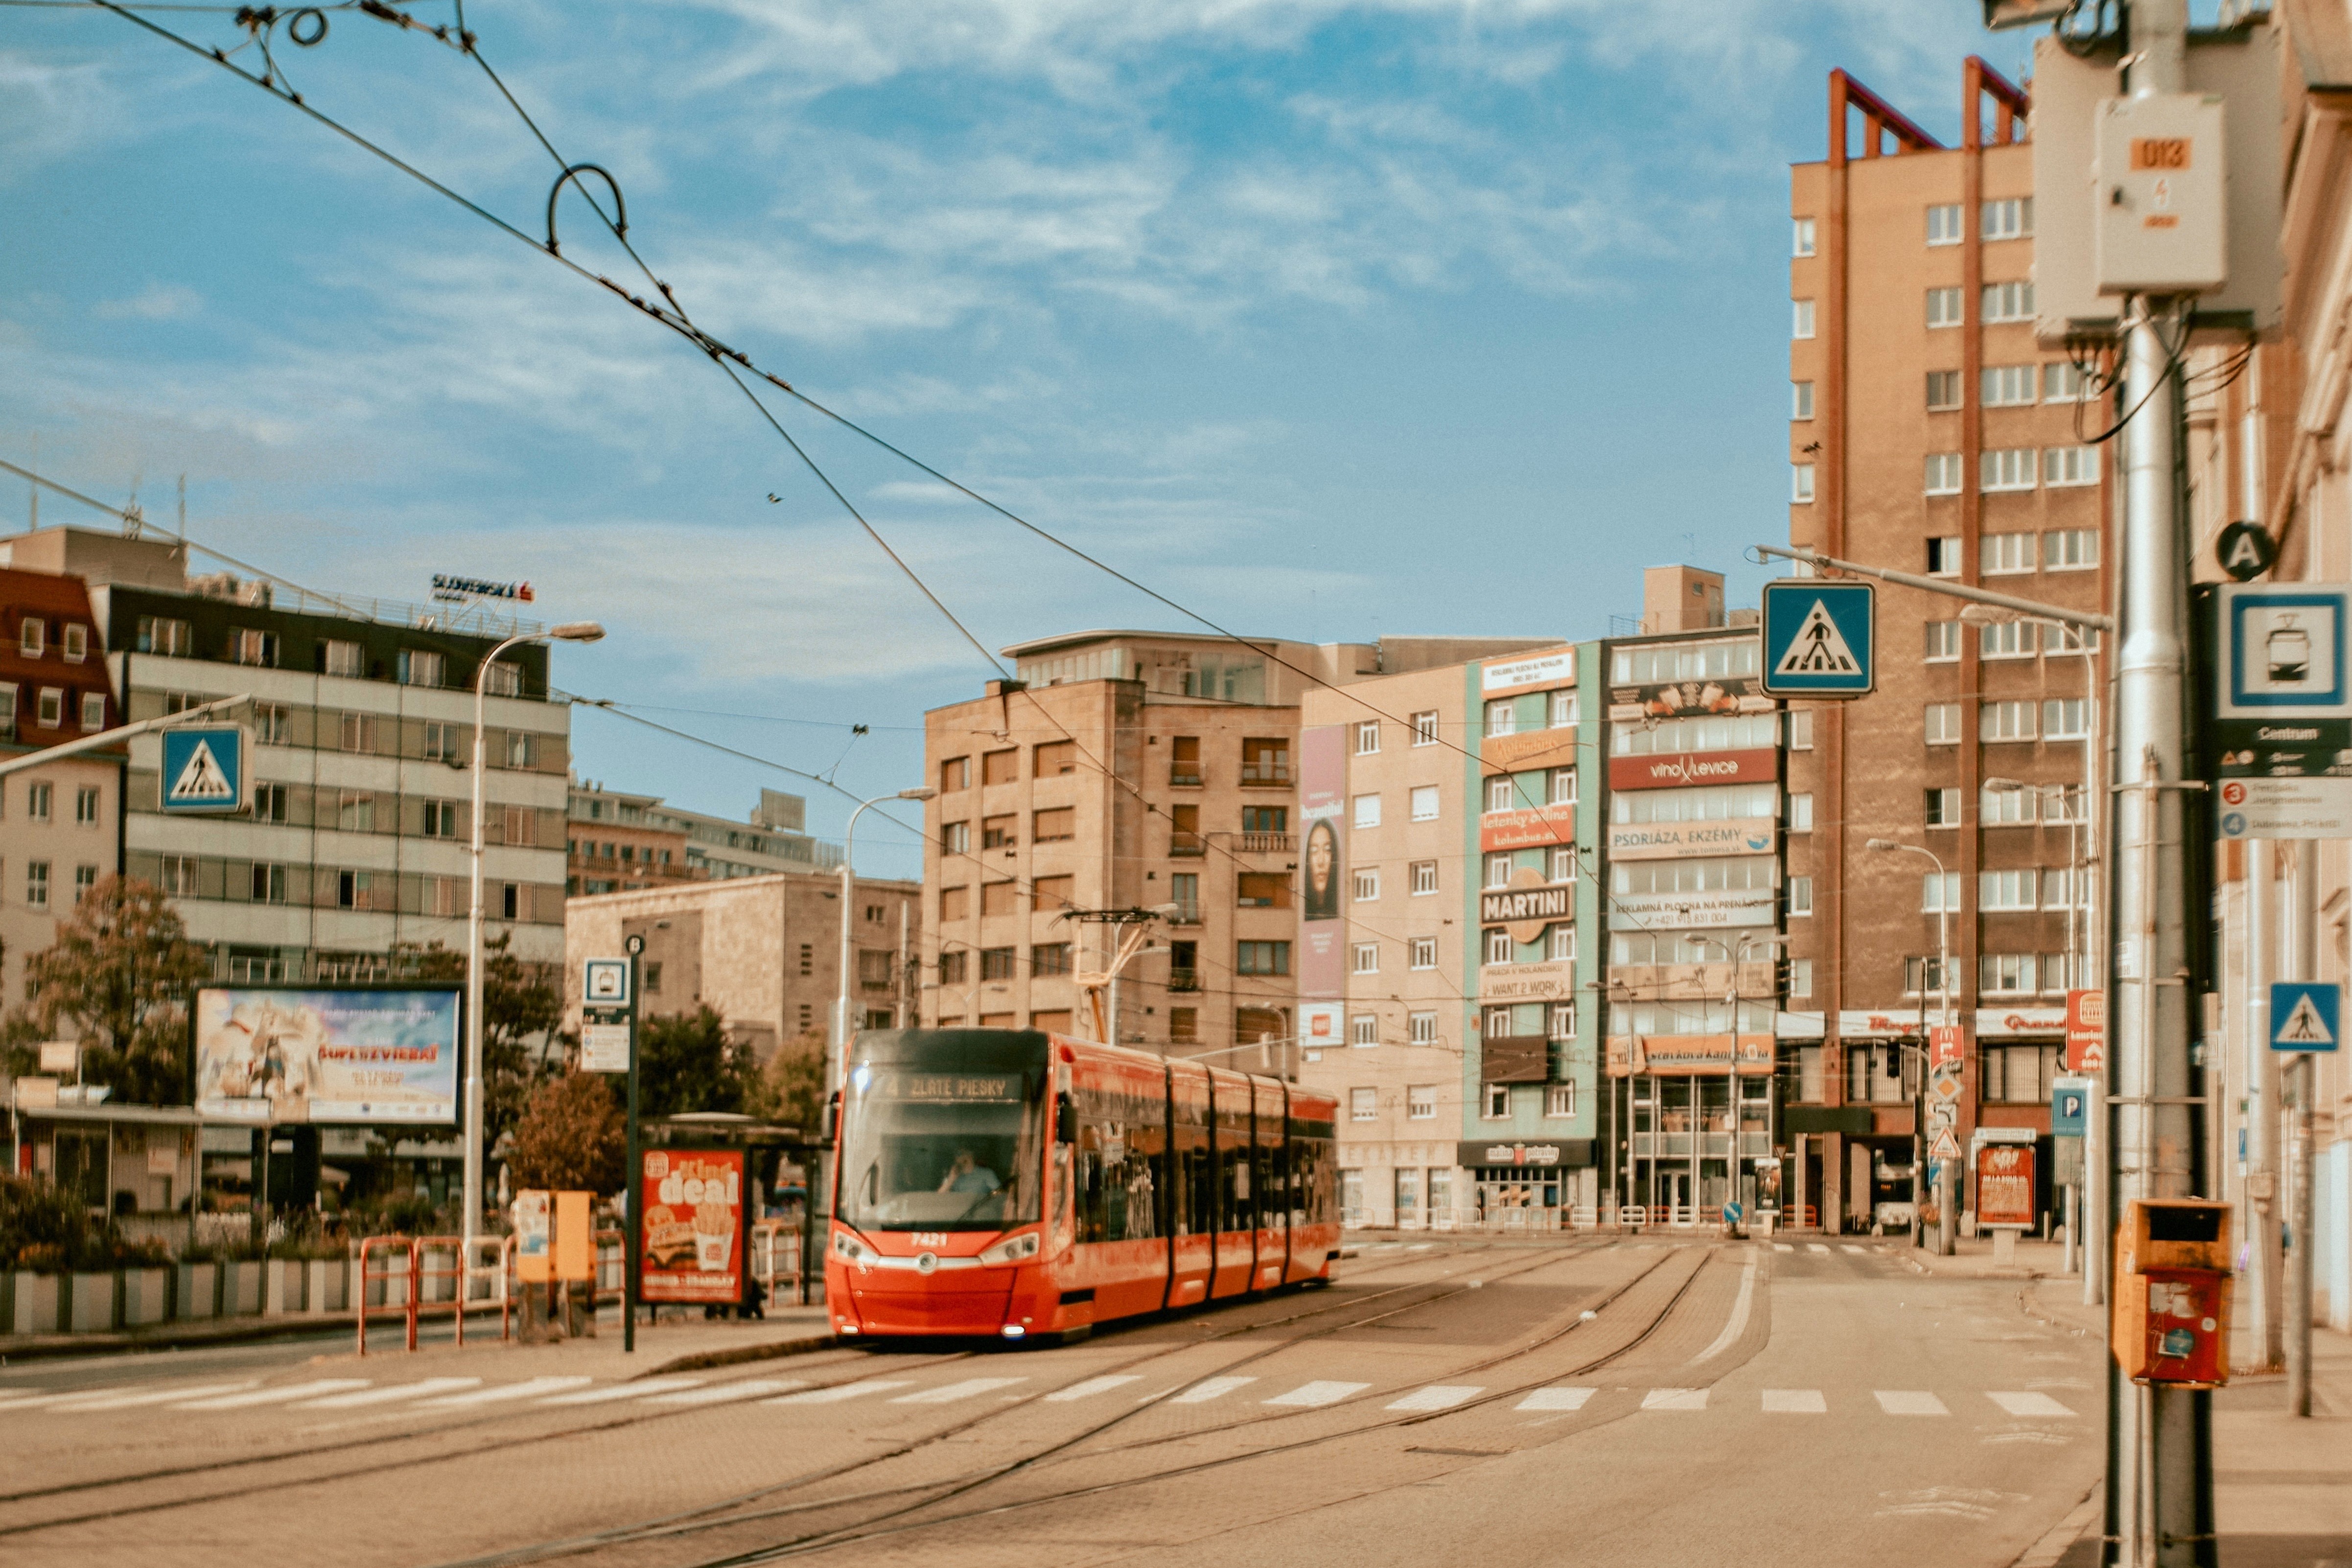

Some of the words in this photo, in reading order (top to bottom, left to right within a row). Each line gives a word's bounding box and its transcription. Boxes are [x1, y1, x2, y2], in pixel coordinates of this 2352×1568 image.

[2228, 533, 2262, 566] A
[1484, 811, 1528, 828] letenky
[1530, 807, 1568, 823] online
[1494, 831, 1557, 846] kolumbus.sk
[1689, 827, 1742, 843] EKZÉMY
[1677, 846, 1741, 856] www.tomesa.sk
[1484, 889, 1566, 920] MARTINI
[629, 936, 641, 954] B
[1493, 982, 1518, 996] WANT
[1521, 983, 1527, 994] 2
[1530, 980, 1557, 994] WORK
[956, 1078, 1006, 1097] PIESKY
[658, 1169, 740, 1205] deal
[910, 1231, 948, 1248] 7421
